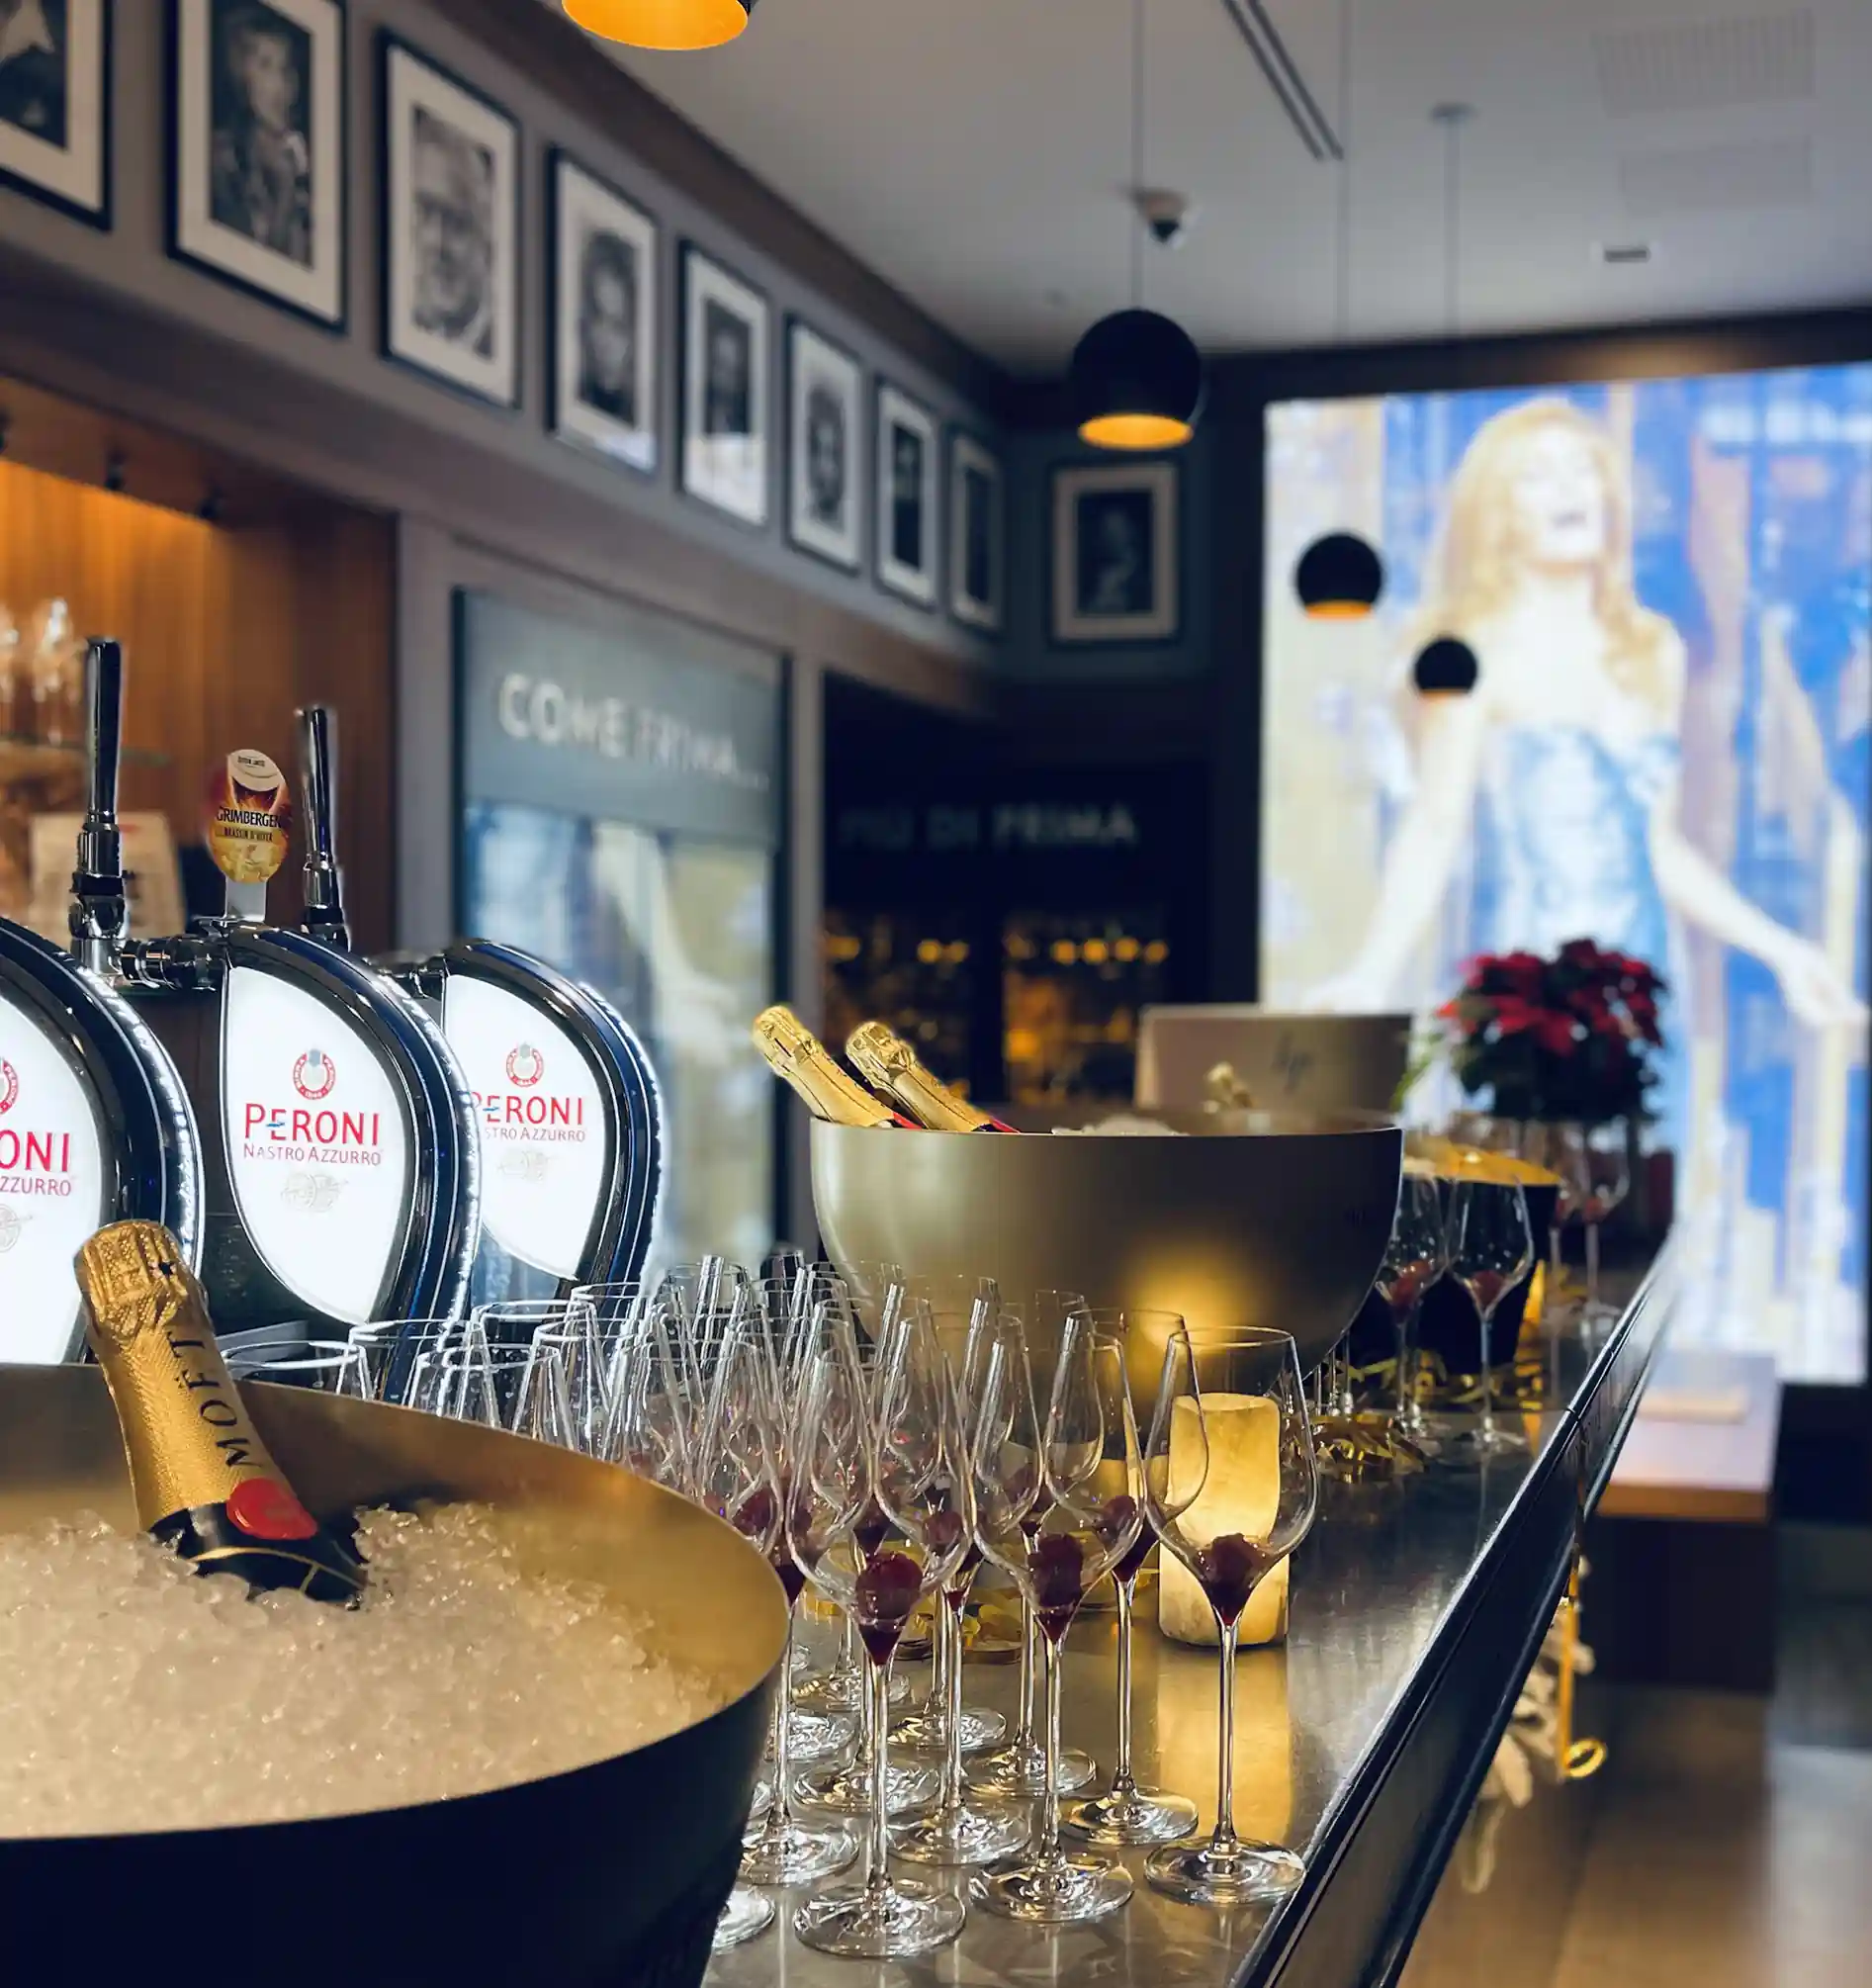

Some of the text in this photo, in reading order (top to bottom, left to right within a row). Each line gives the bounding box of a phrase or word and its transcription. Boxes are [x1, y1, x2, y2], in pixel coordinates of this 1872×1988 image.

[217, 807, 282, 829] GRIMBERGEN
[992, 801, 1139, 850] PRIMA
[244, 1103, 380, 1146] PERONI
[519, 1127, 585, 1142] AZZURRO
[243, 1143, 382, 1166] NASTRO AZZURRO
